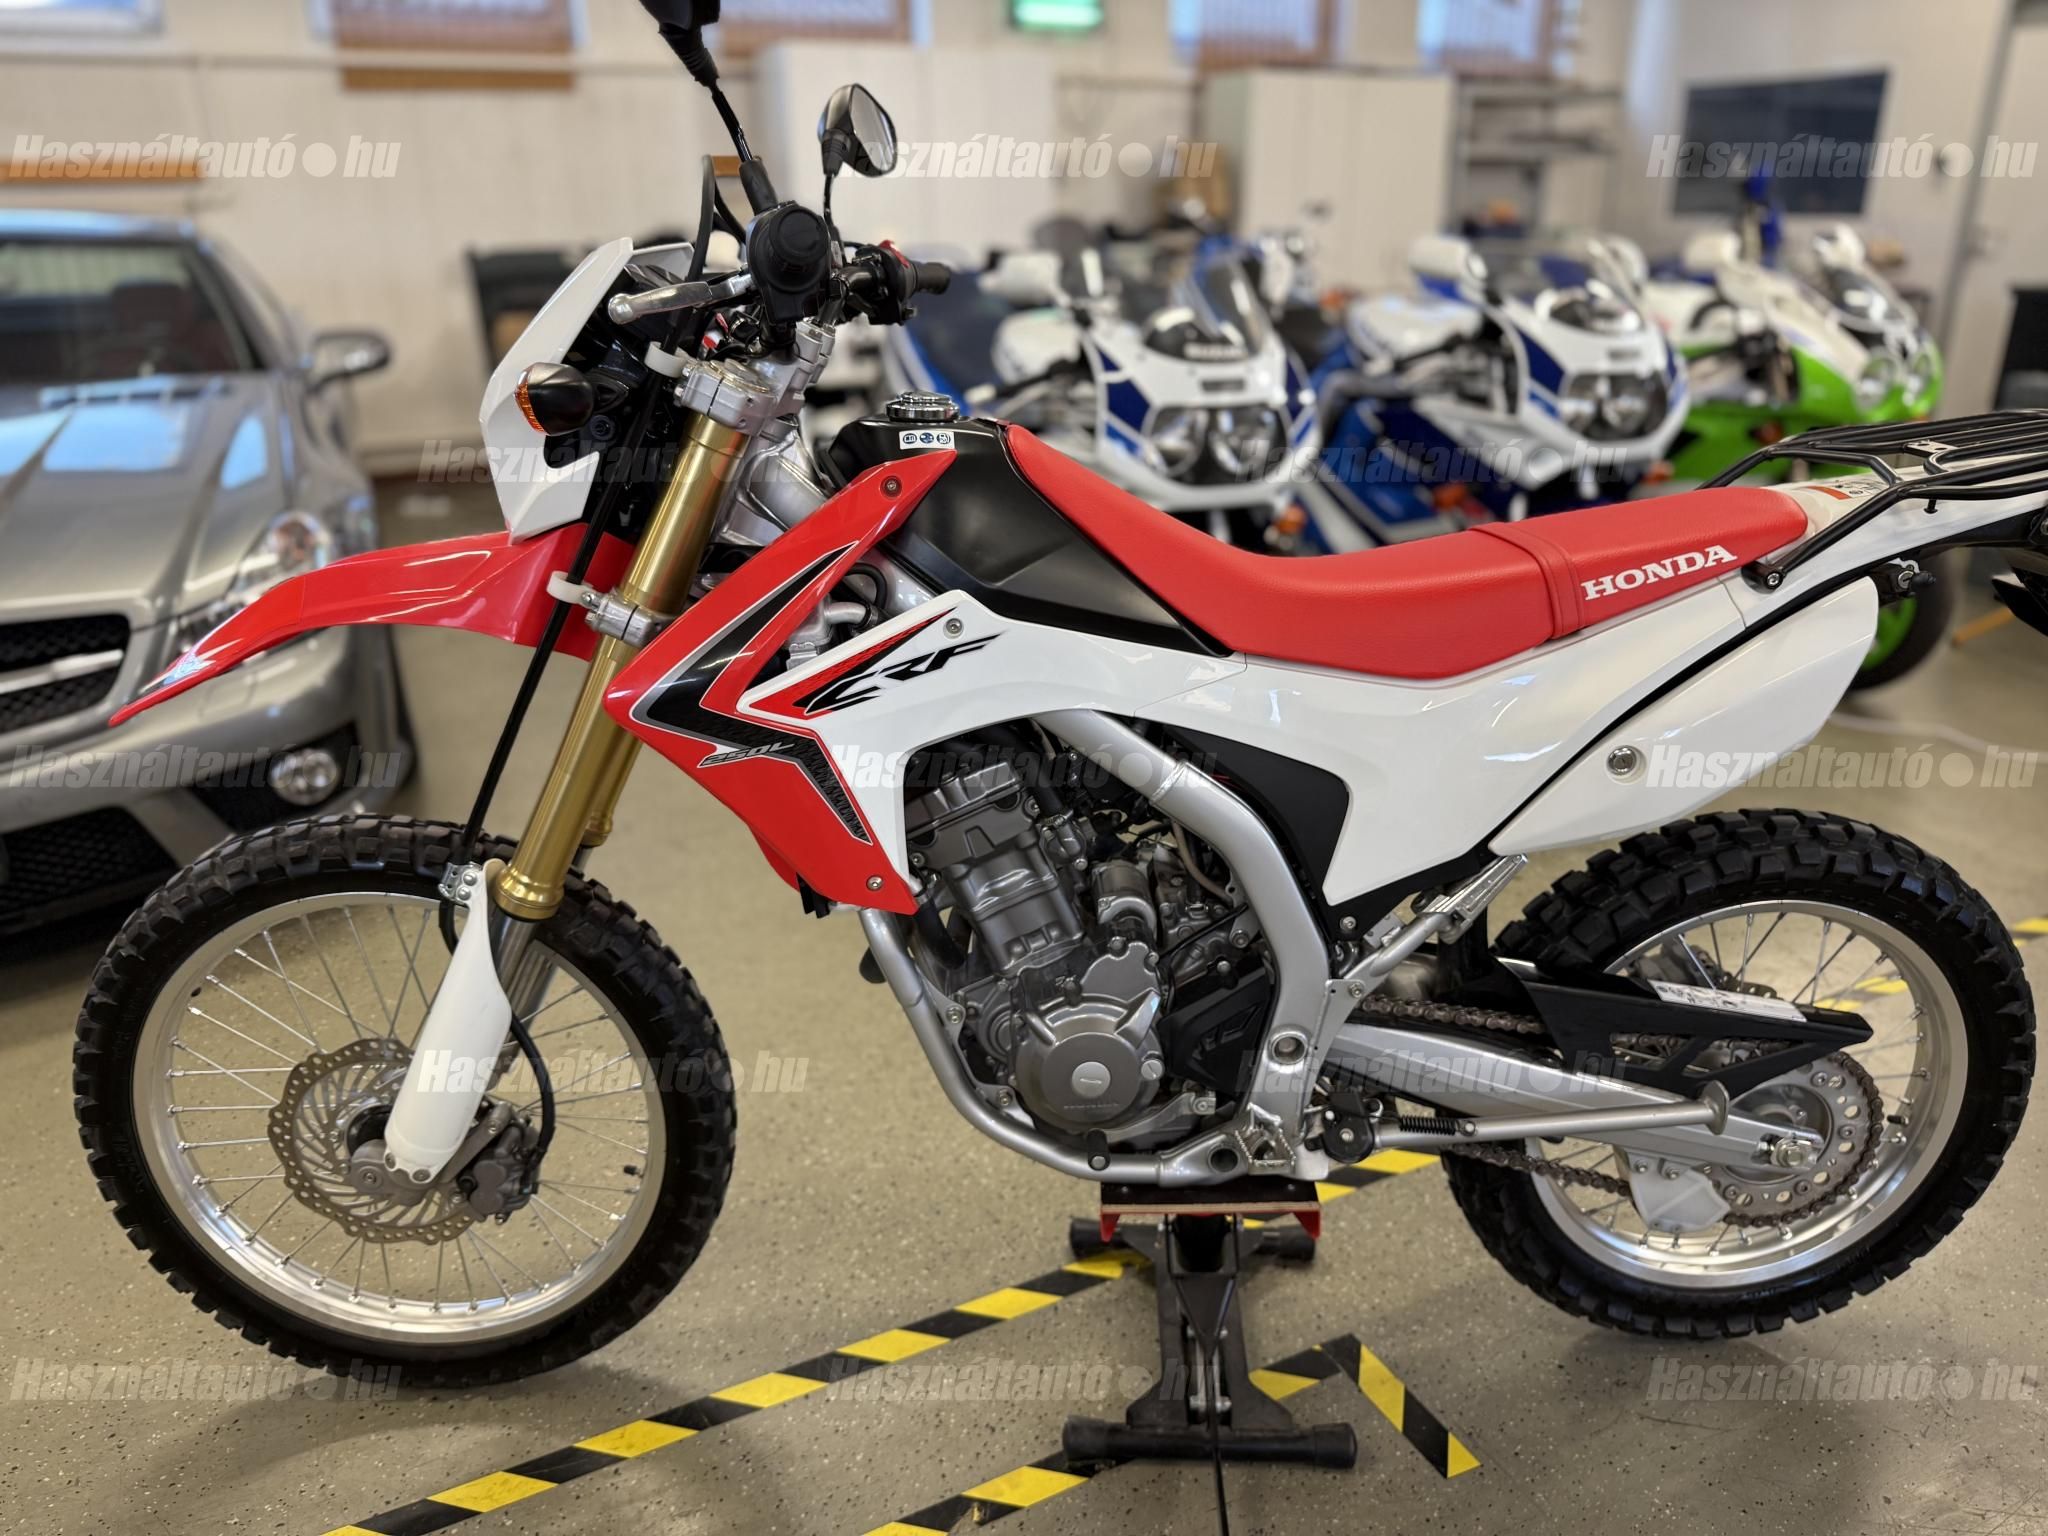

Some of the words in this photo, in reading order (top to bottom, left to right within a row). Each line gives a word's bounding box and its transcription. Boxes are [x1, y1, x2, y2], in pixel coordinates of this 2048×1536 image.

[1580, 544, 1738, 600] HONDA
[805, 628, 1008, 712] CRF
[701, 741, 795, 767] 250L
